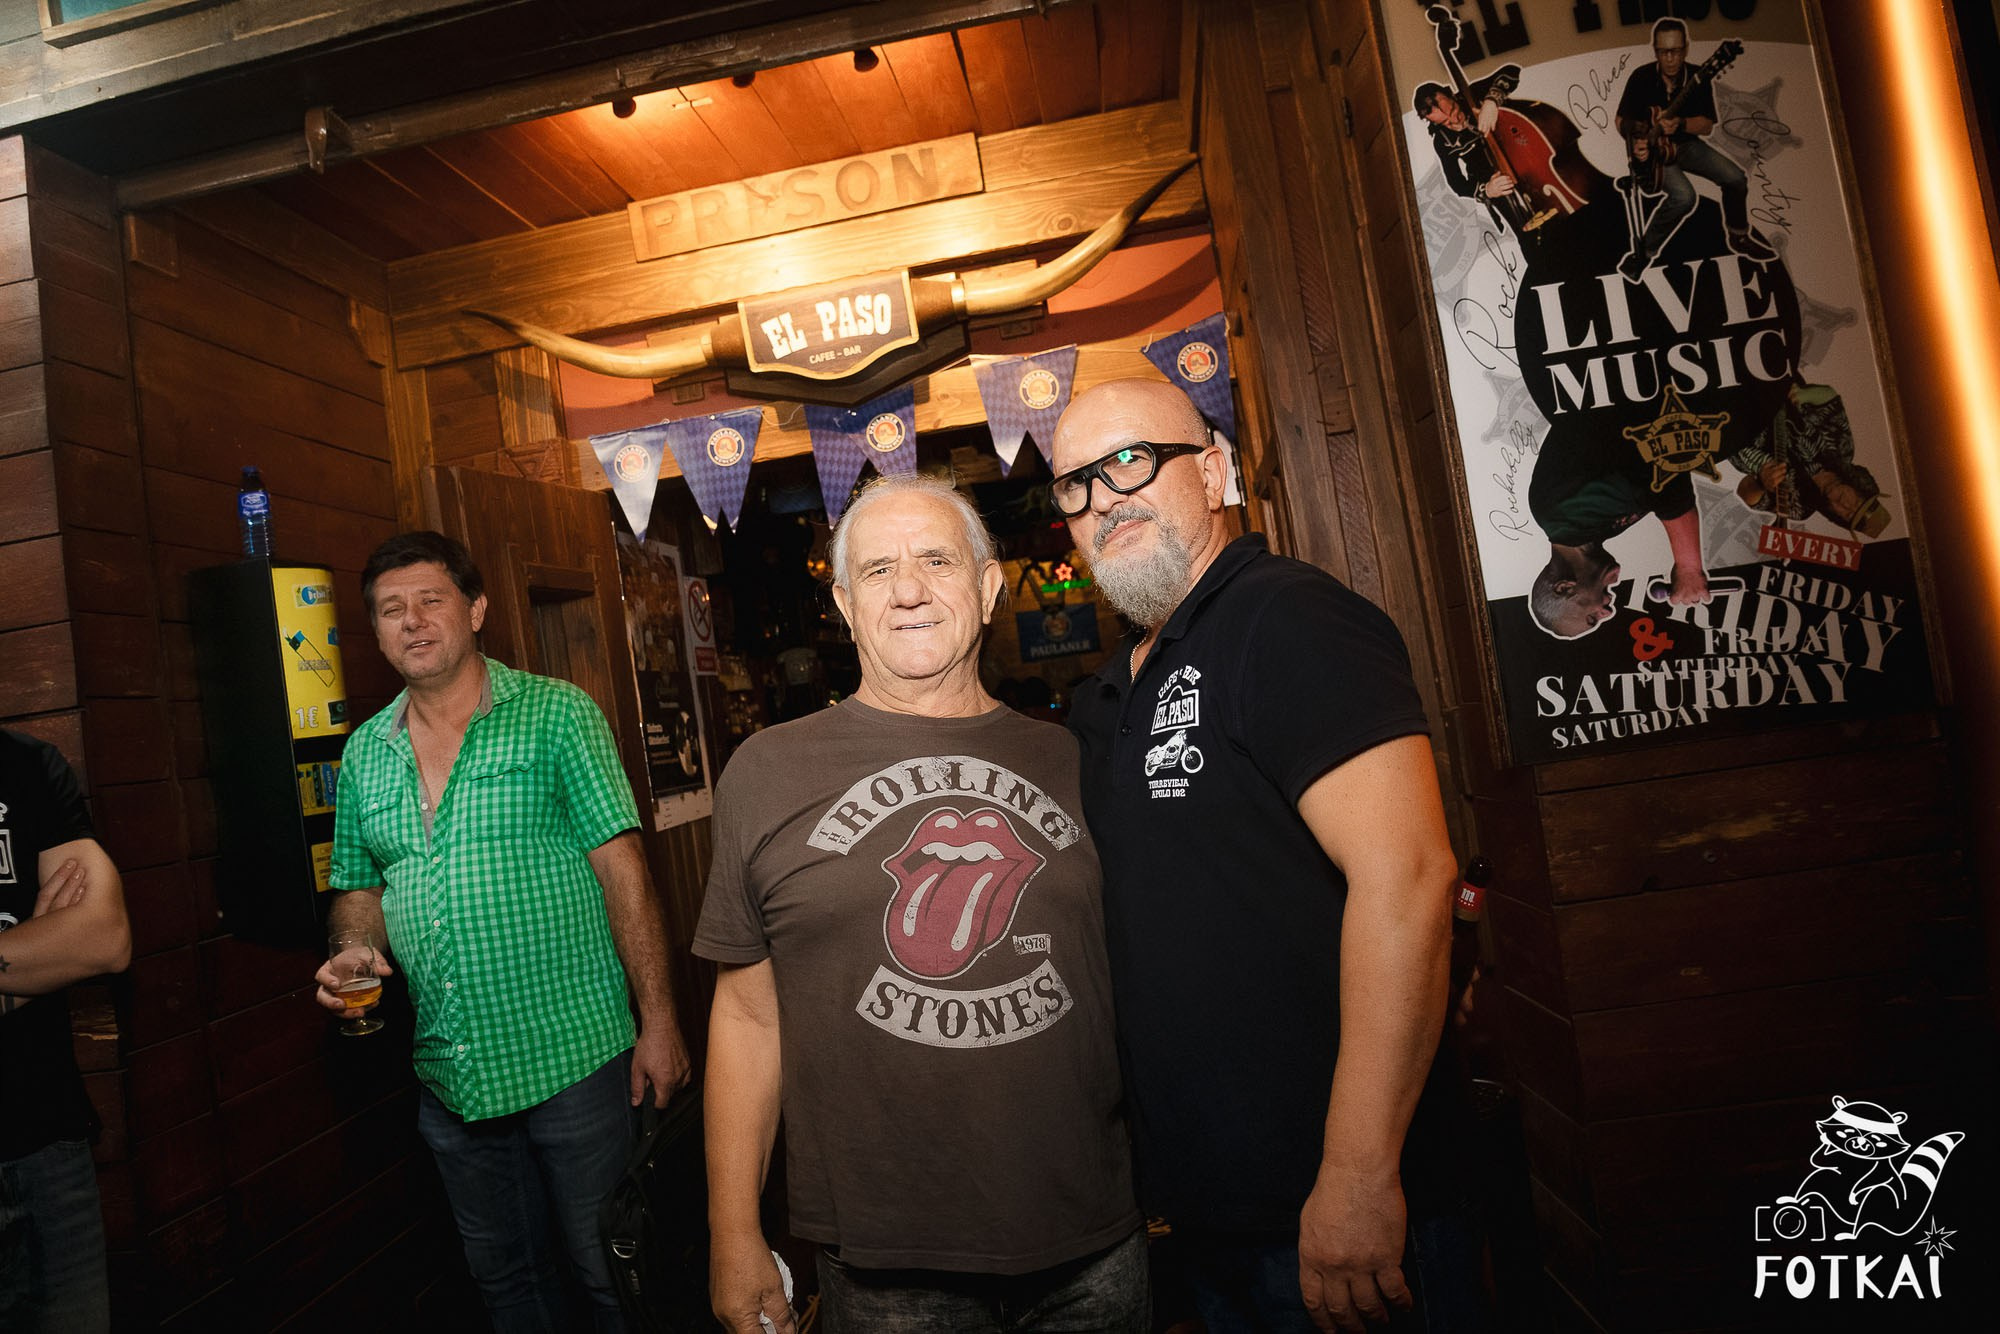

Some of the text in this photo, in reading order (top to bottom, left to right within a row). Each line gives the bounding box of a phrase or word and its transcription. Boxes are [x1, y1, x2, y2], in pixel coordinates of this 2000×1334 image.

[1567, 52, 1632, 136] Blues
[1722, 110, 1802, 235] Country
[760, 293, 892, 360] EL PASO
[1453, 230, 1519, 371] Rock
[1530, 255, 1779, 355] LIVE
[844, 345, 862, 357] BAR
[1545, 328, 1793, 415] MUSIC
[1648, 431, 1709, 457] EL PASO
[1488, 420, 1538, 541] Rockabilly
[1765, 530, 1859, 567] EVERY
[1756, 564, 1904, 624] FRIDAY
[1629, 617, 1674, 661] &
[1182, 665, 1202, 686] BAR
[1536, 662, 1852, 718] SATURDAY
[295, 706, 319, 729] 1€
[1154, 697, 1194, 729] EL PASO
[1551, 702, 1710, 750] SATURDAY
[828, 760, 1070, 842] ROLLING
[1148, 778, 1189, 789] TORREVIEJA
[1151, 788, 1186, 798] APOLO 102
[1019, 937, 1046, 950] 1978
[866, 972, 1065, 1039] STONES
